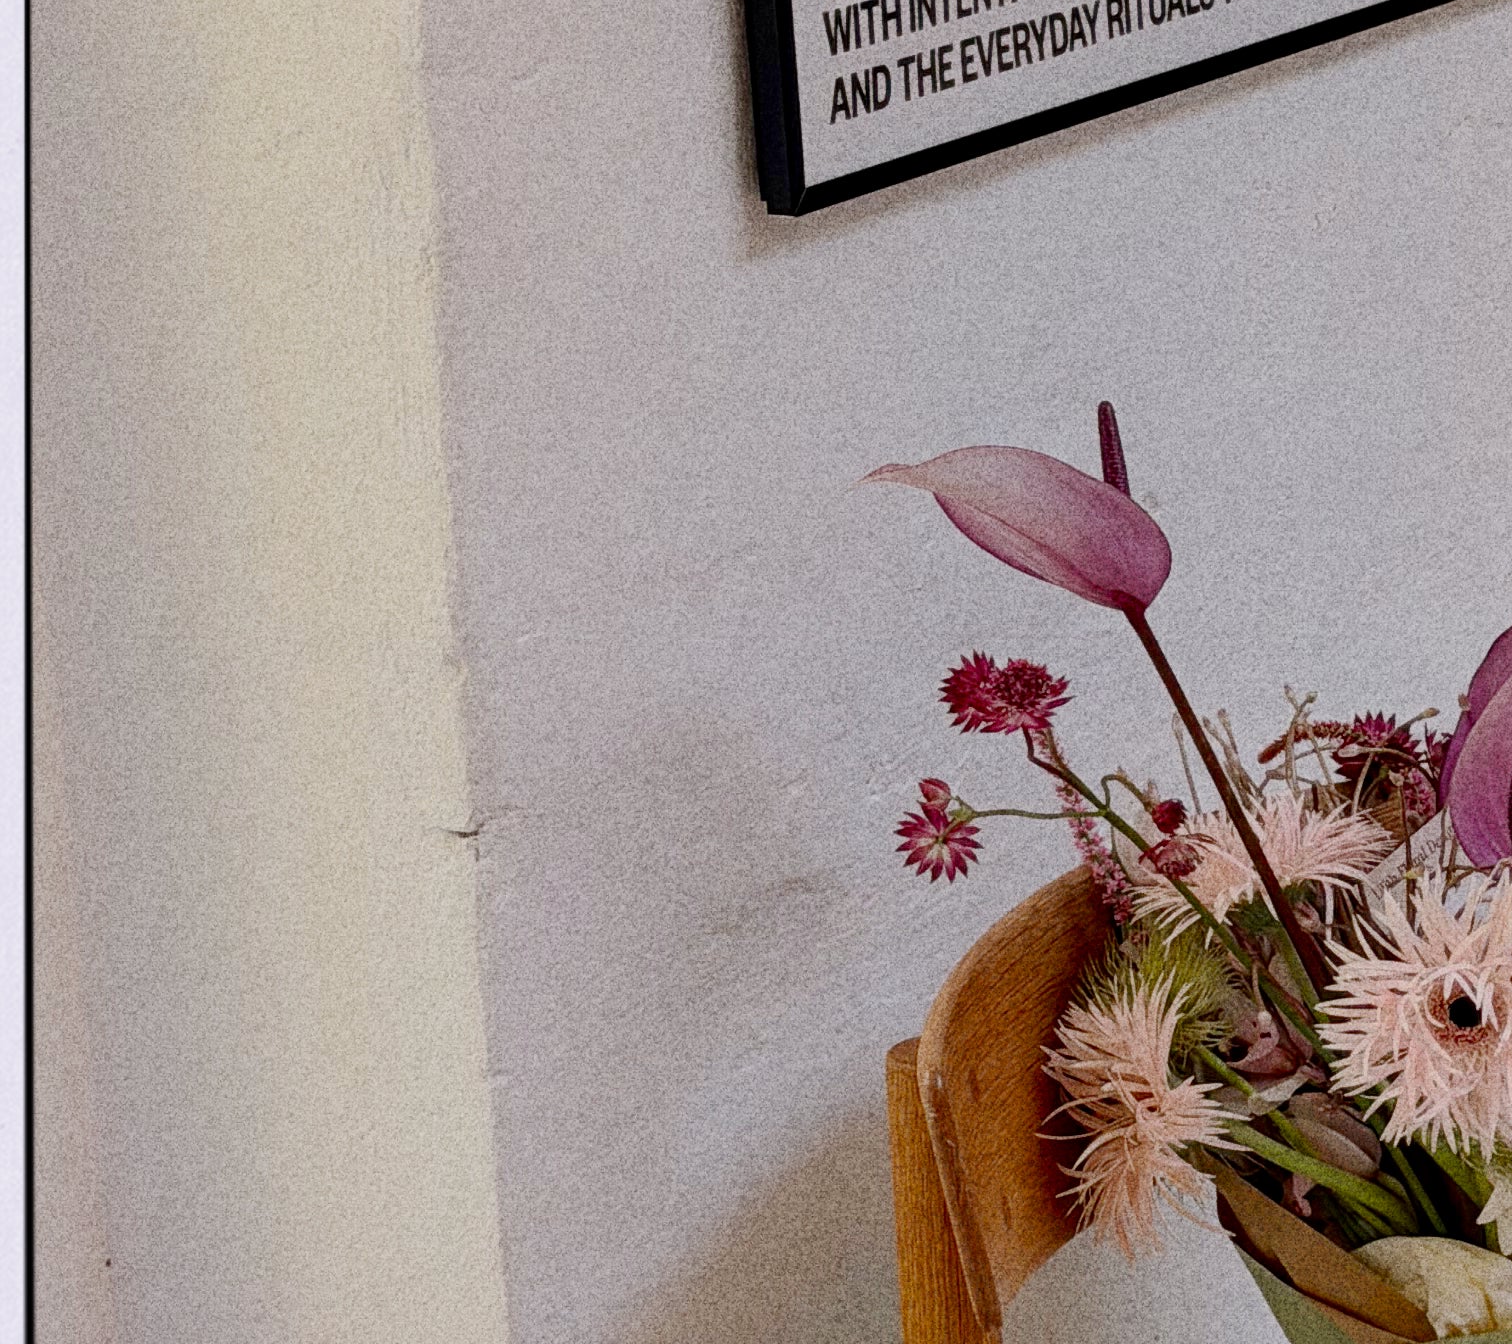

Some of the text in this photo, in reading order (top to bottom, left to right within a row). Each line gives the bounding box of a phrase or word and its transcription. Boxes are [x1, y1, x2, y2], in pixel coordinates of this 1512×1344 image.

[828, 63, 892, 125] AND
[897, 43, 956, 102] THE
[961, 0, 1101, 84] EVERYDAY
